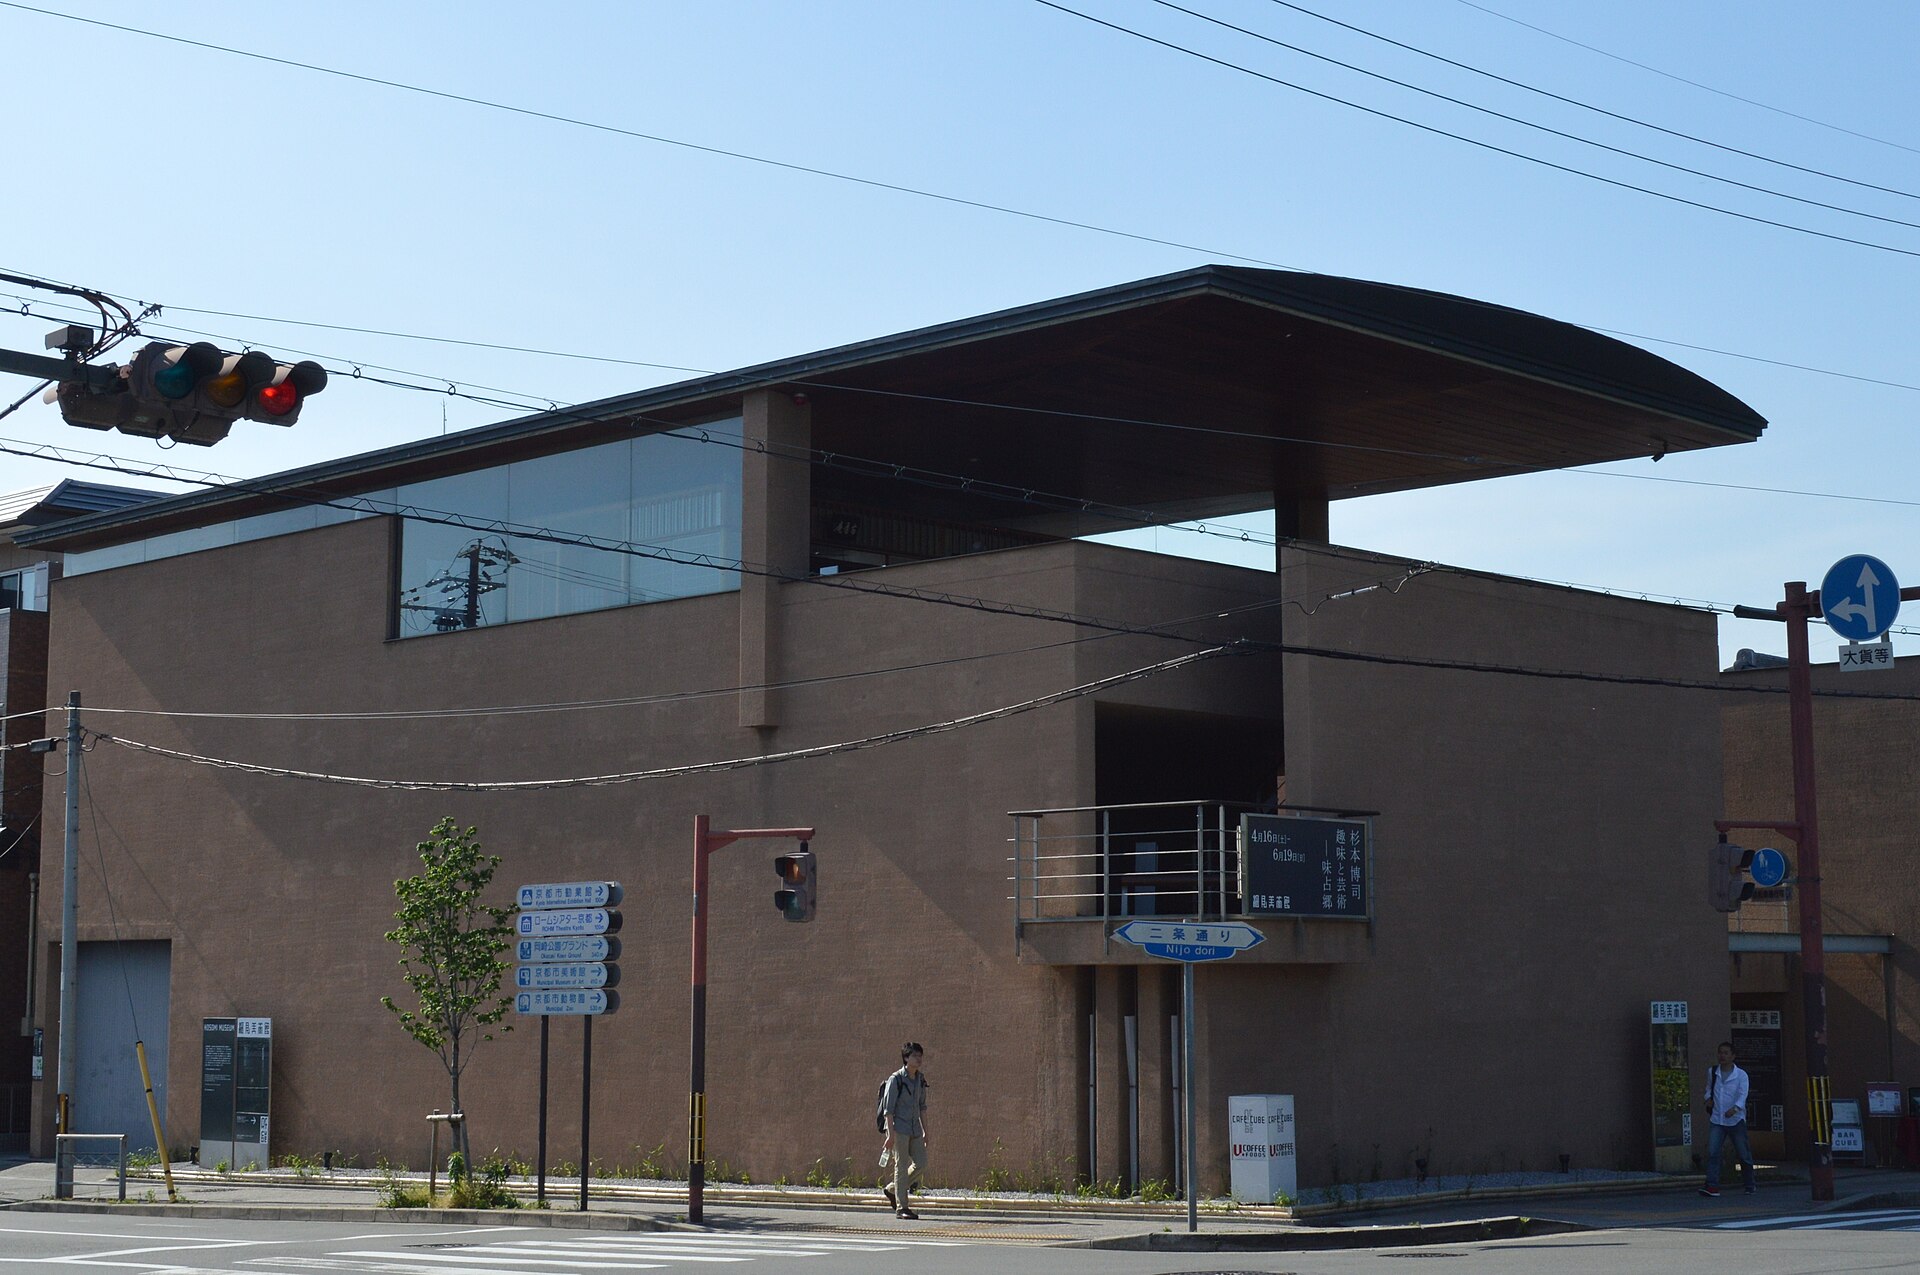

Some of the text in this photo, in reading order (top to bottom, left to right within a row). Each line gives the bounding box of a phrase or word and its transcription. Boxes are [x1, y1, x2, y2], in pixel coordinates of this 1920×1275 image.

[1843, 648, 1889, 666] 大貨等
[1336, 828, 1347, 910] 趣味と芸術
[1349, 829, 1361, 900] 杉本博司
[535, 913, 593, 926] ロームシアター京都
[1150, 927, 1231, 943] 二条通り
[1166, 944, 1215, 956] Nijo dori
[535, 967, 586, 978] 京都市美術館
[535, 993, 586, 1004] 京都市動物園
[1249, 1115, 1265, 1124] CUBE
[1280, 1113, 1293, 1123] CUBE
[1243, 1144, 1266, 1153] COFFEE
[1276, 1142, 1294, 1152] COFFEE
